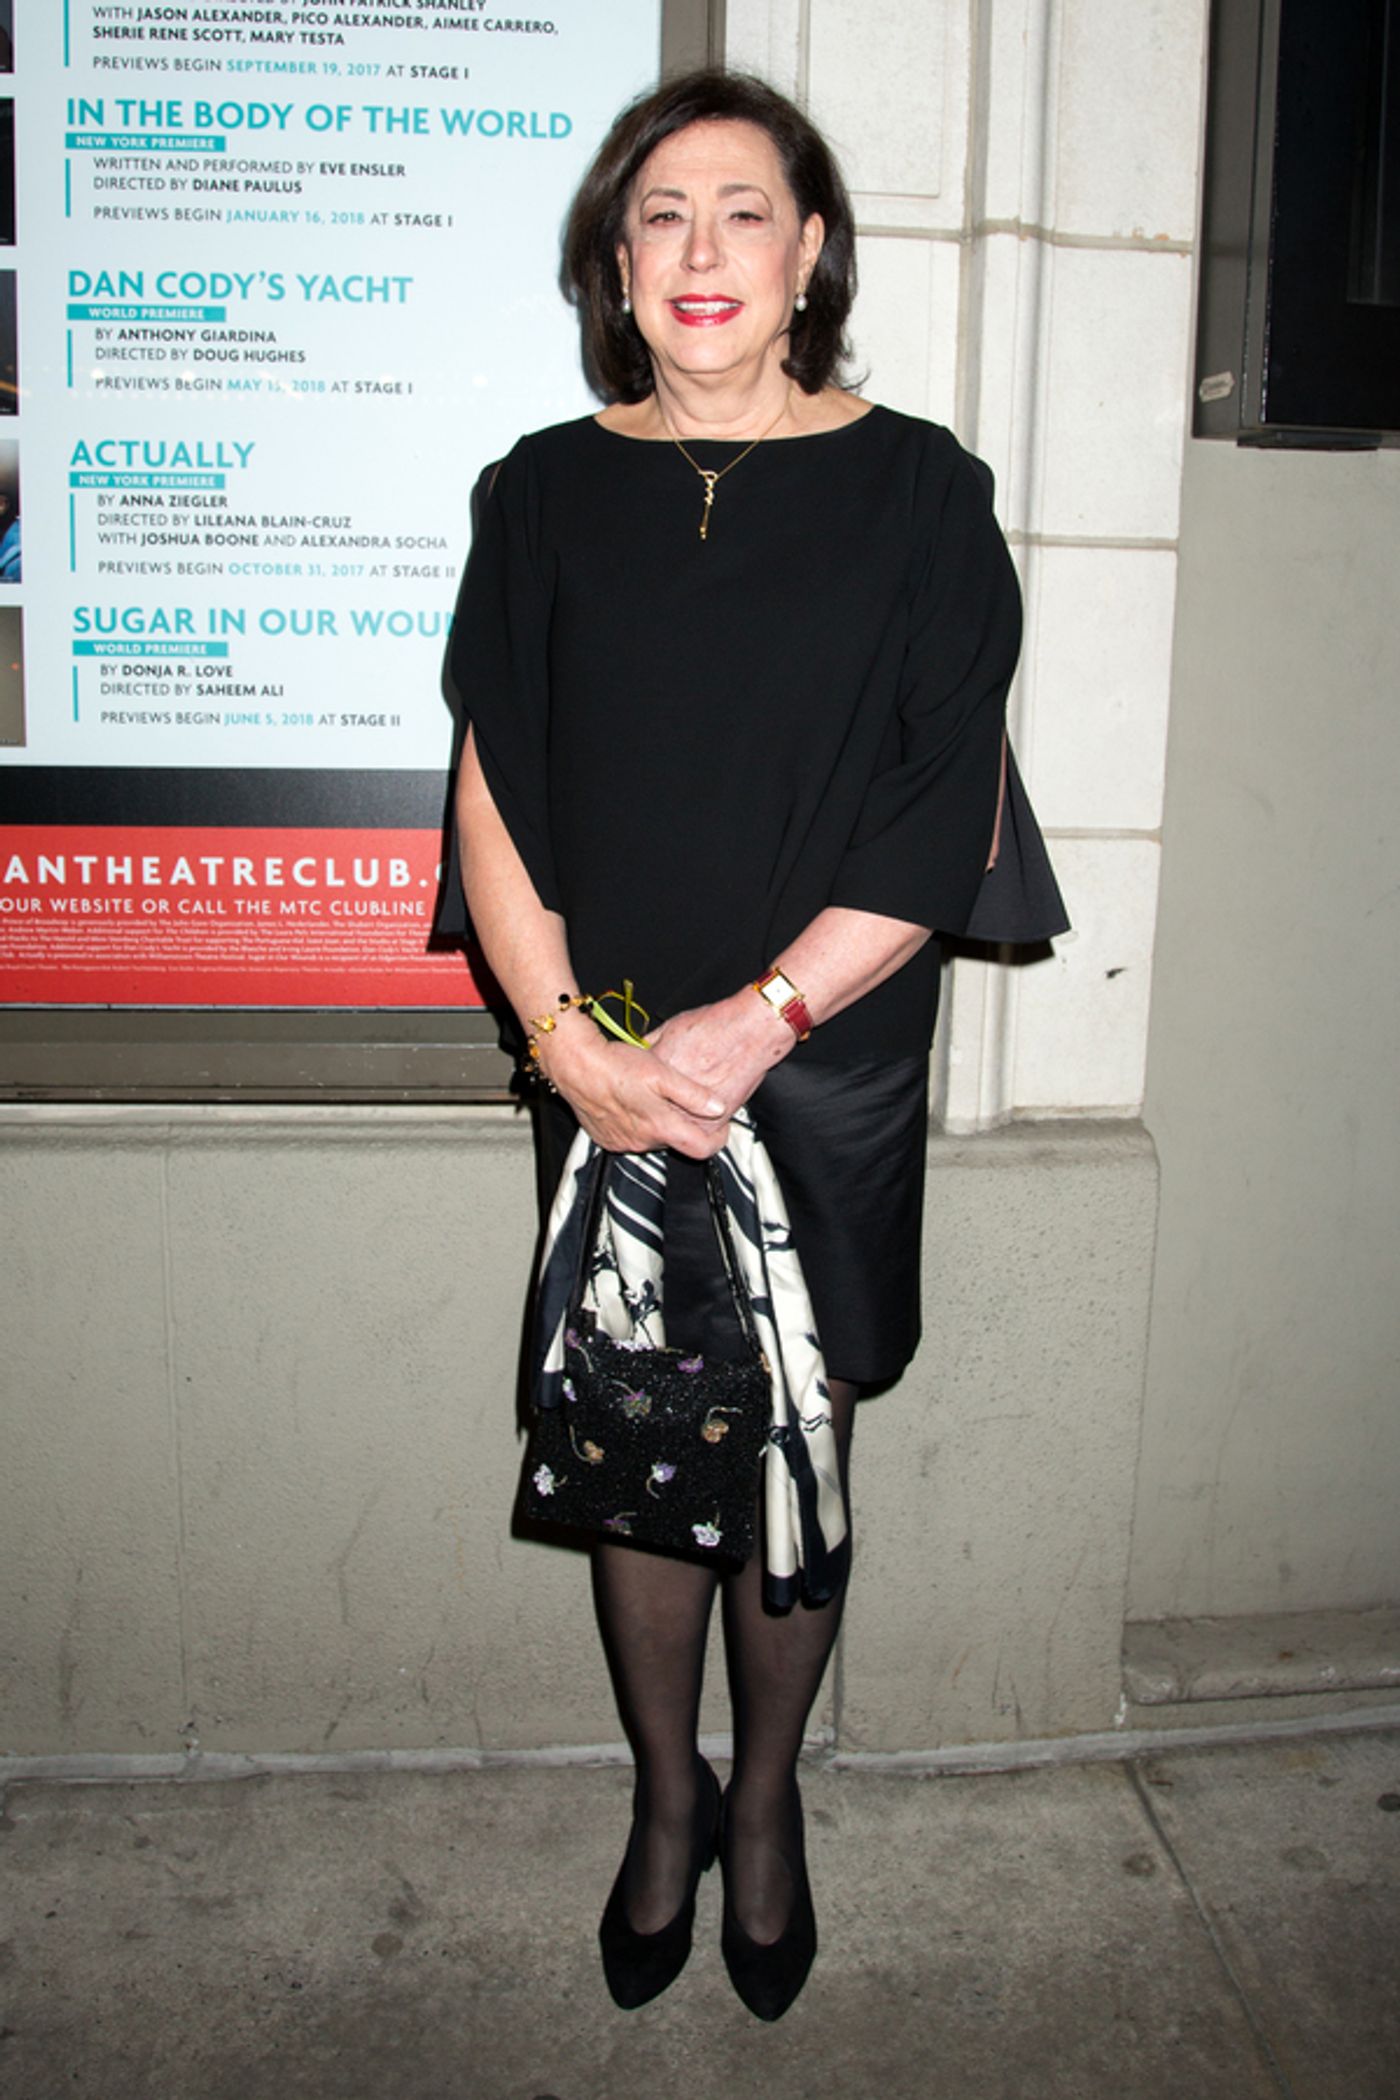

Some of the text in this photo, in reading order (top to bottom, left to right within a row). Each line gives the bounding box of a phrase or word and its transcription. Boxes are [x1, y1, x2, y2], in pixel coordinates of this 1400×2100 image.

[417, 0, 486, 10] SHANLEY
[93, 7, 558, 33] WITH JASON ALEXANDER, PICO ALEXANDER, AIMEE CARRERO,
[93, 26, 344, 44] SHERIE RENE SCOTT, MARY TESTA
[93, 56, 469, 79] PREVIEWS BEGIN SEPTEMBER 19, 2017 AT STAGE I
[67, 98, 572, 138] IN THE BODY OF THE WORLD
[76, 136, 214, 149] NEW YORK PREMIERE
[93, 157, 405, 176] WRITTEN AND PERFORMED BY EVE ENSLER
[94, 177, 302, 193] DIRECTED BY DIANE PAULUS
[93, 206, 453, 227] PREVIEWS BEGIN JANUARY 16, 2018 AT STAGE I
[68, 270, 413, 302] DAN CODY'S YACHT
[88, 308, 204, 320] WORLD PREMIERE
[95, 328, 276, 342] BY ANTHONY GIARDINA
[95, 347, 306, 362] DIRECTED BY DOUG HUGHES
[95, 376, 170, 390] PREVIEWS
[174, 378, 222, 391] BEGIN
[227, 379, 262, 390] MAY
[292, 380, 326, 392] 2018
[331, 380, 349, 392] AT
[354, 381, 402, 394] STAGE
[408, 382, 412, 394] I
[70, 440, 254, 467] ACTUALLY
[79, 475, 215, 486] NEW YORK PREMIERE
[97, 494, 228, 507] BY ANNA ZIEGLER
[98, 513, 351, 528] DIRECTED BY LILEANA BLAIN-CRUZ
[98, 532, 447, 548] WITH JOSHUA BOONE AND ALEXANDRA SOCHA
[98, 561, 456, 577] PREVIEWS BEGIN OCTOBER 31, 2017 AT STAGE II
[73, 607, 196, 633] SUGAR
[209, 609, 245, 634] IN
[259, 609, 337, 635] OUR
[93, 643, 206, 654] WORLD PREMIERE
[100, 664, 232, 678] BY DONJA R. LOVE
[100, 683, 284, 696] DIRECTED BY SAHEEM ALI
[100, 712, 400, 726] PREVIEWS BEGIN JUNE 5, 2018 AT STAGE II
[0, 898, 425, 915] OUR WEBSITE OR CALL THE MTC CLUBLINE
